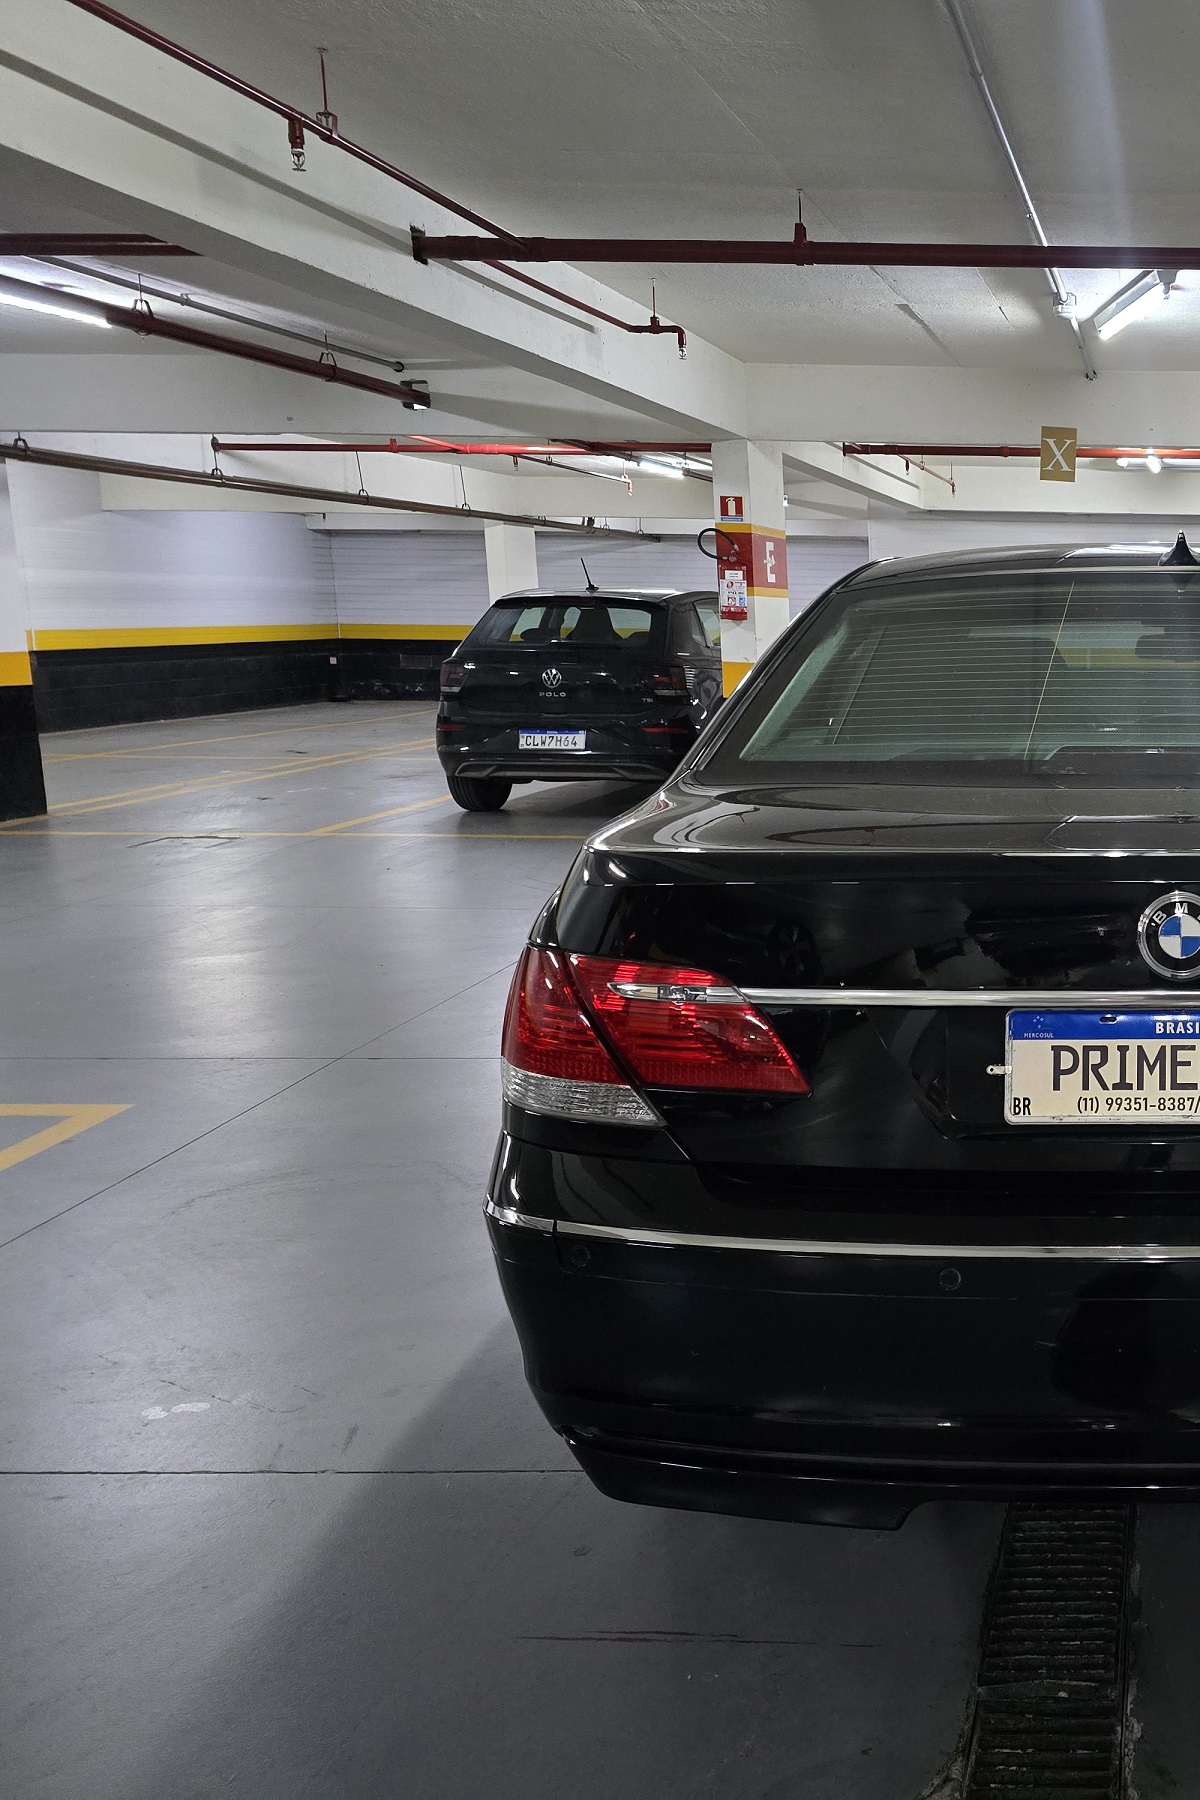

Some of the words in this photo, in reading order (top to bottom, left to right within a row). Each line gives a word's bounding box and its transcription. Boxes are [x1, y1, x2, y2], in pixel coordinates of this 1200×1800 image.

[1042, 437, 1075, 472] X
[525, 735, 578, 747] CLW7H64
[1012, 1097, 1032, 1116] BR
[1077, 1096, 1100, 1114] (11)
